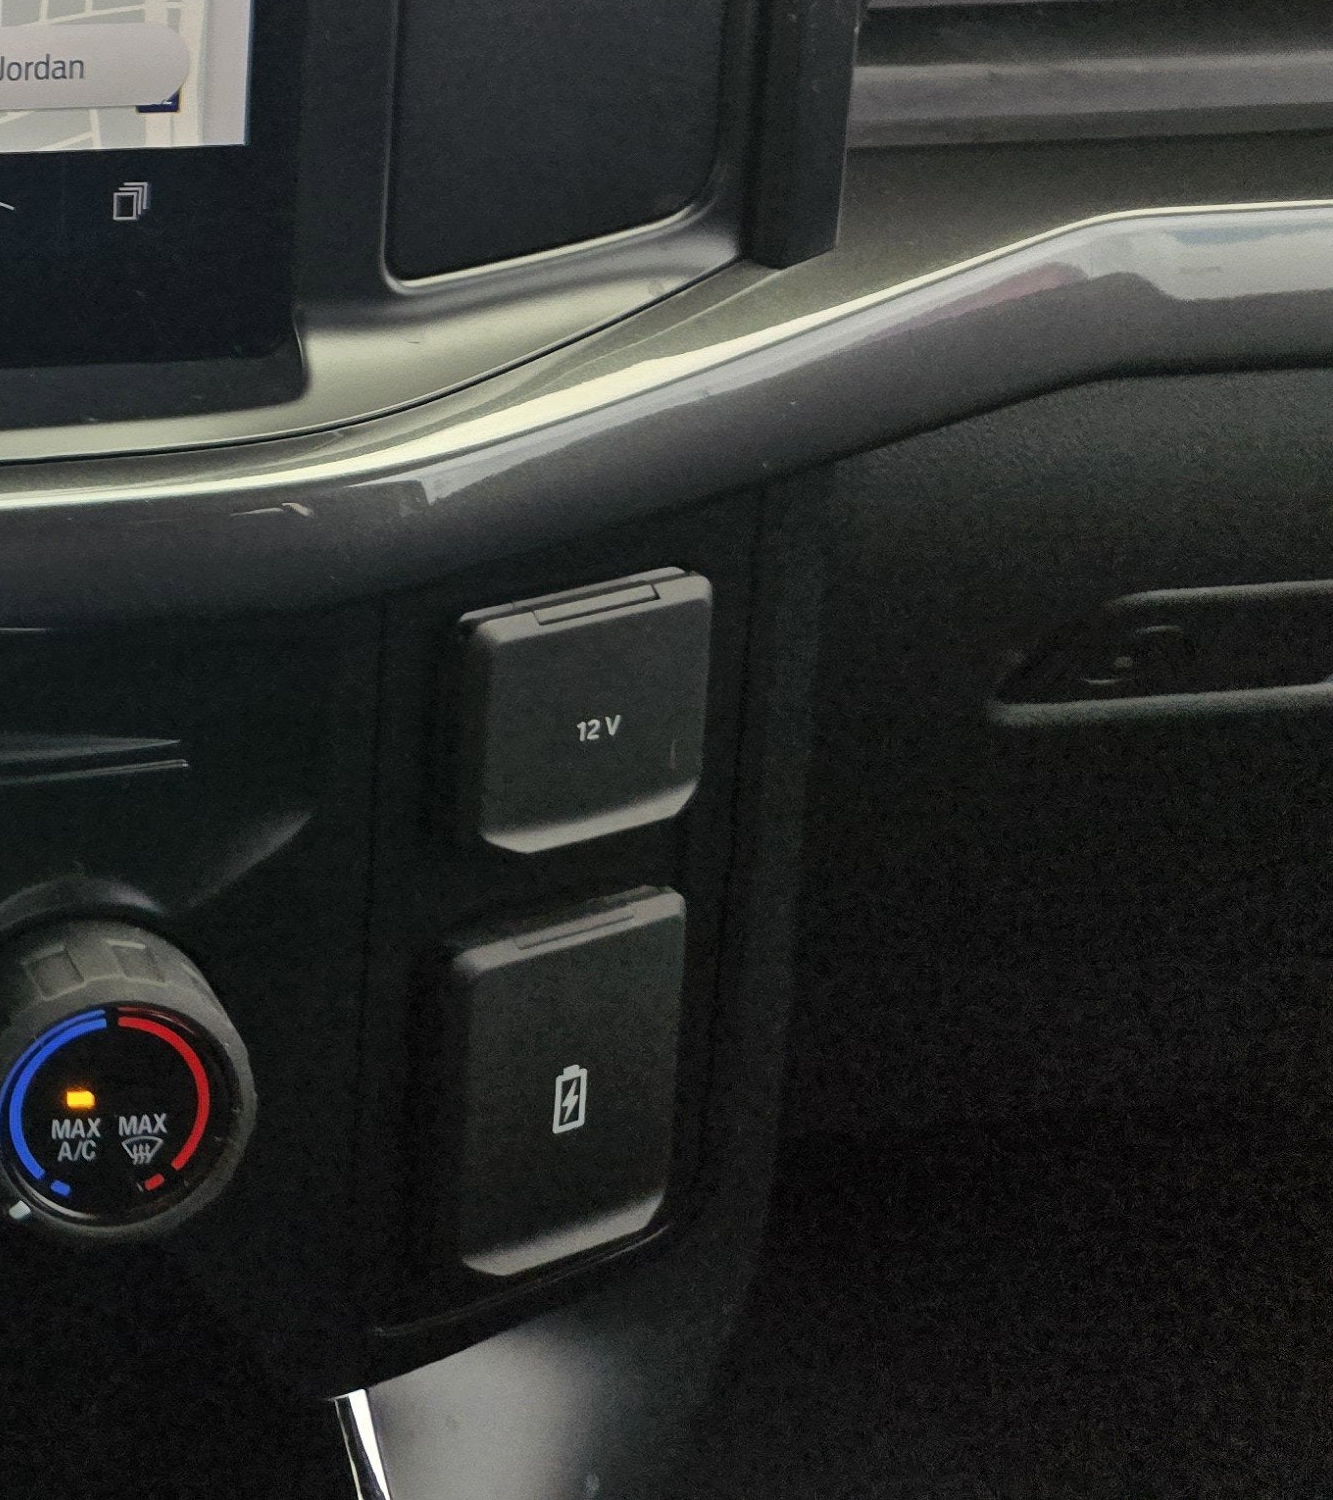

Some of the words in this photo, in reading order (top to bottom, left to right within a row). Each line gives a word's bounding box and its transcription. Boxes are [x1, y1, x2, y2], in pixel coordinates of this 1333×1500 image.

[576, 718, 601, 742] 12
[604, 714, 622, 736] V
[51, 1117, 101, 1140] MAX
[118, 1112, 168, 1136] MAX
[57, 1139, 97, 1162] A/C
